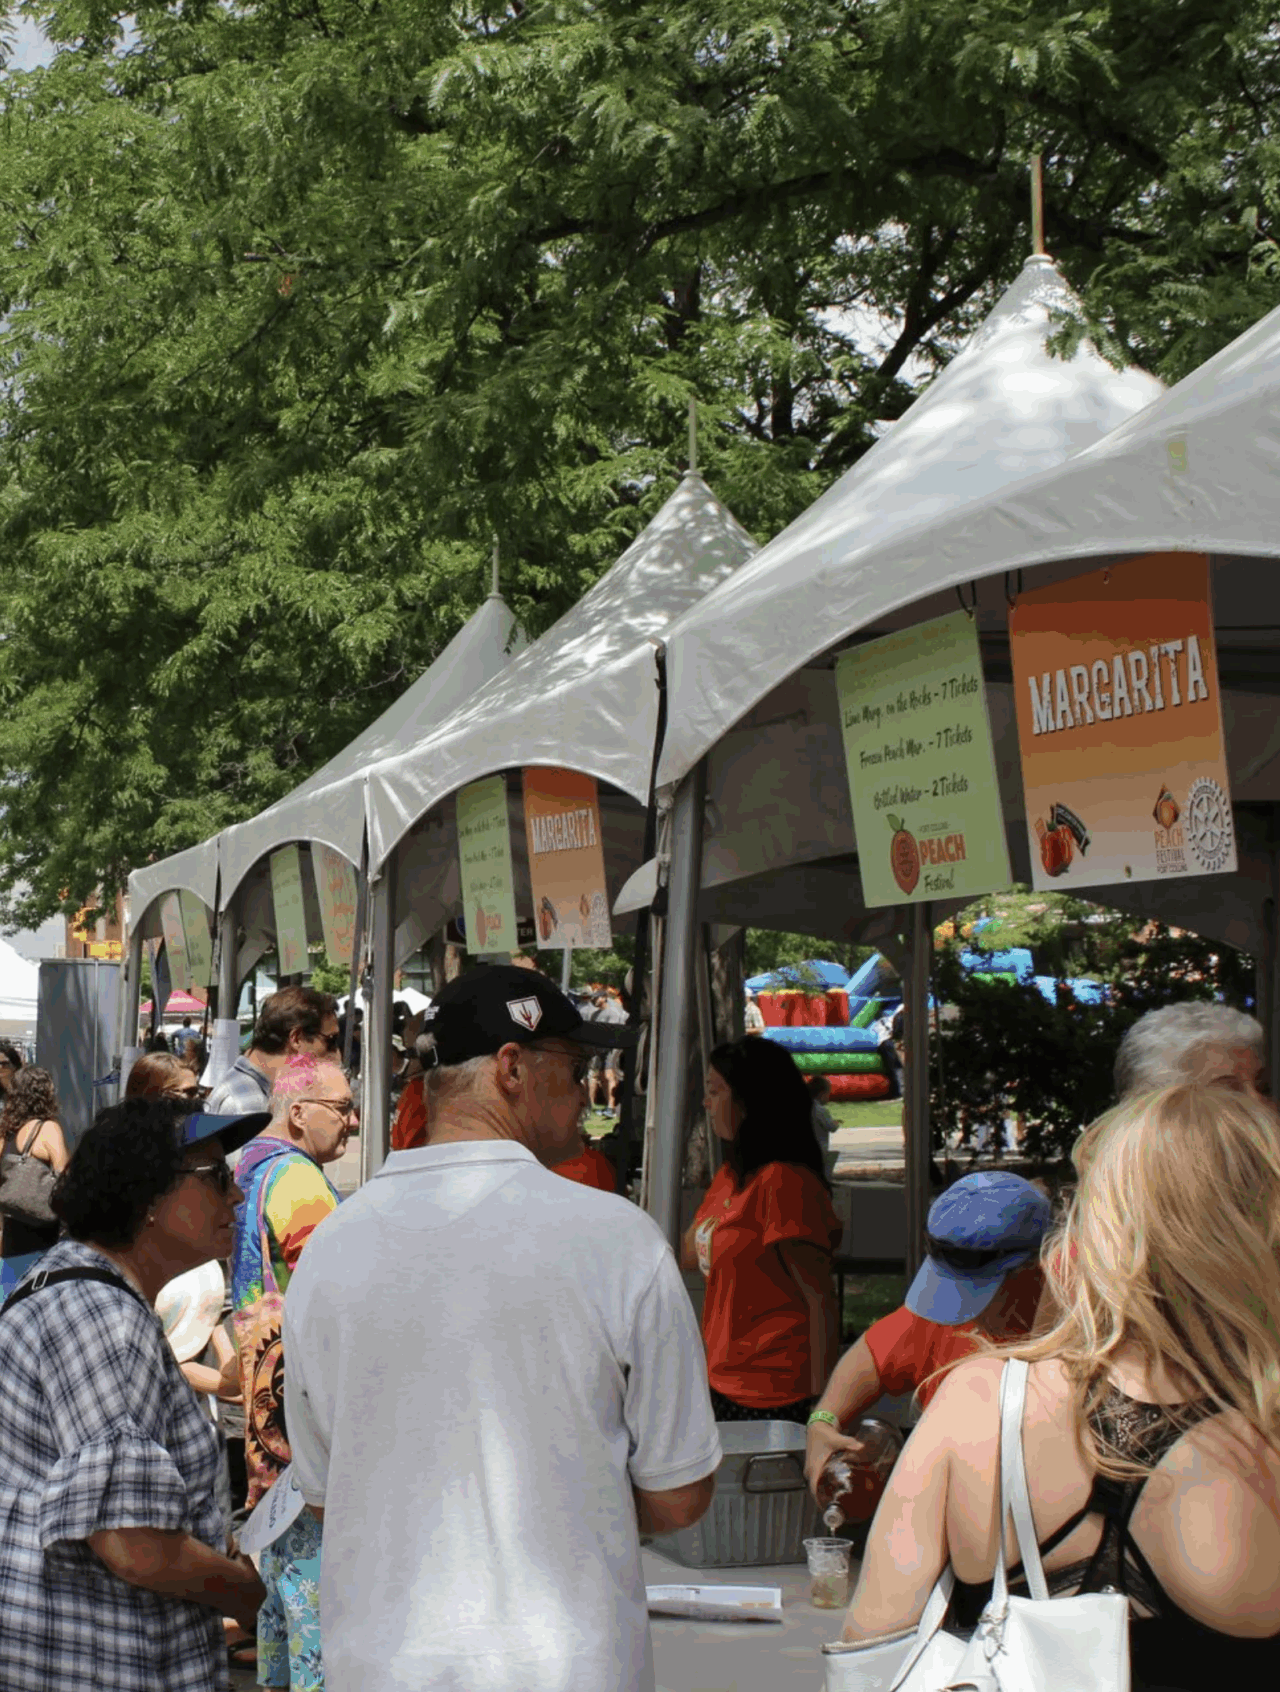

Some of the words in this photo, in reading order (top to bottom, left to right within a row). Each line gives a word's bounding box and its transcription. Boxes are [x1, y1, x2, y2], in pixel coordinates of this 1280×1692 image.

[886, 703, 895, 715] on
[896, 692, 908, 713] the
[909, 684, 932, 710] Rocks
[941, 682, 948, 700] 7
[948, 673, 979, 699] Tickets
[1028, 635, 1209, 736] MARGARITA
[884, 737, 905, 762] Peach
[936, 731, 942, 749] 7
[943, 723, 973, 748] Tickets
[873, 784, 899, 811] Bottled
[900, 785, 922, 805] Water
[932, 779, 939, 797] 2
[939, 772, 969, 797] Tickets
[530, 808, 597, 855] MARGARITA
[919, 833, 966, 866] PEACH
[1154, 828, 1184, 849] PEACH
[924, 867, 955, 893] Festival
